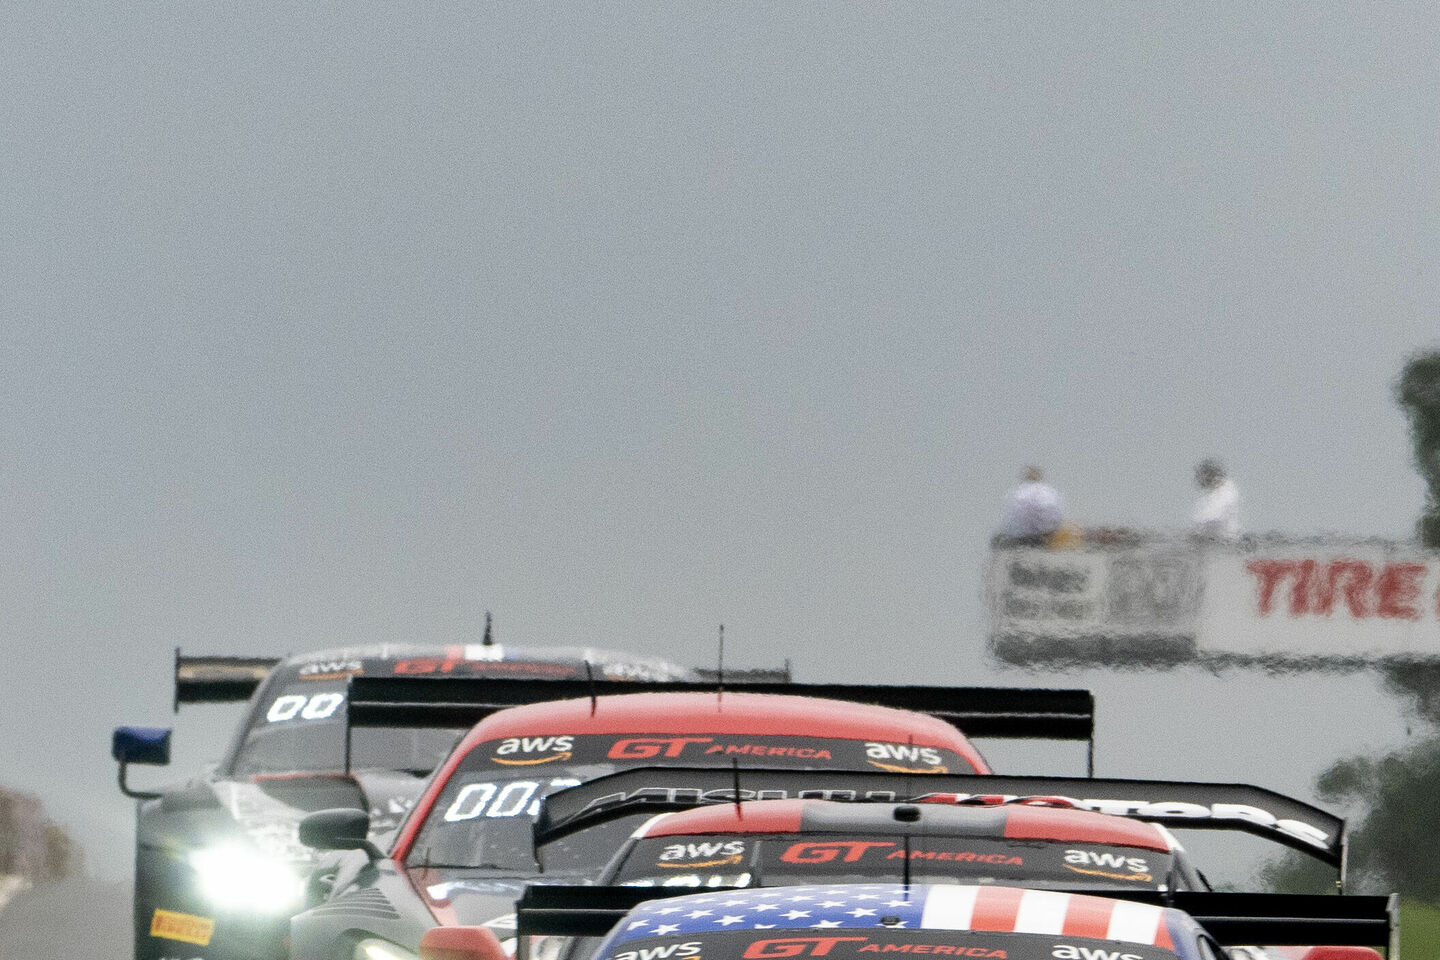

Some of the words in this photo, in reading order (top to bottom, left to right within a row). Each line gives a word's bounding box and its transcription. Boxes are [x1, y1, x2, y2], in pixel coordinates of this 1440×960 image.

[1244, 558, 1428, 619] TIRE
[497, 736, 575, 756] aws
[607, 738, 713, 760] GT
[705, 743, 833, 760] AMERICA
[865, 742, 943, 766] aws
[659, 841, 746, 861] aws
[780, 841, 896, 864] GT
[887, 849, 1024, 866] AMERICA
[1064, 848, 1150, 873] aws
[743, 937, 868, 960] GT
[862, 943, 1009, 960] AMERICA
